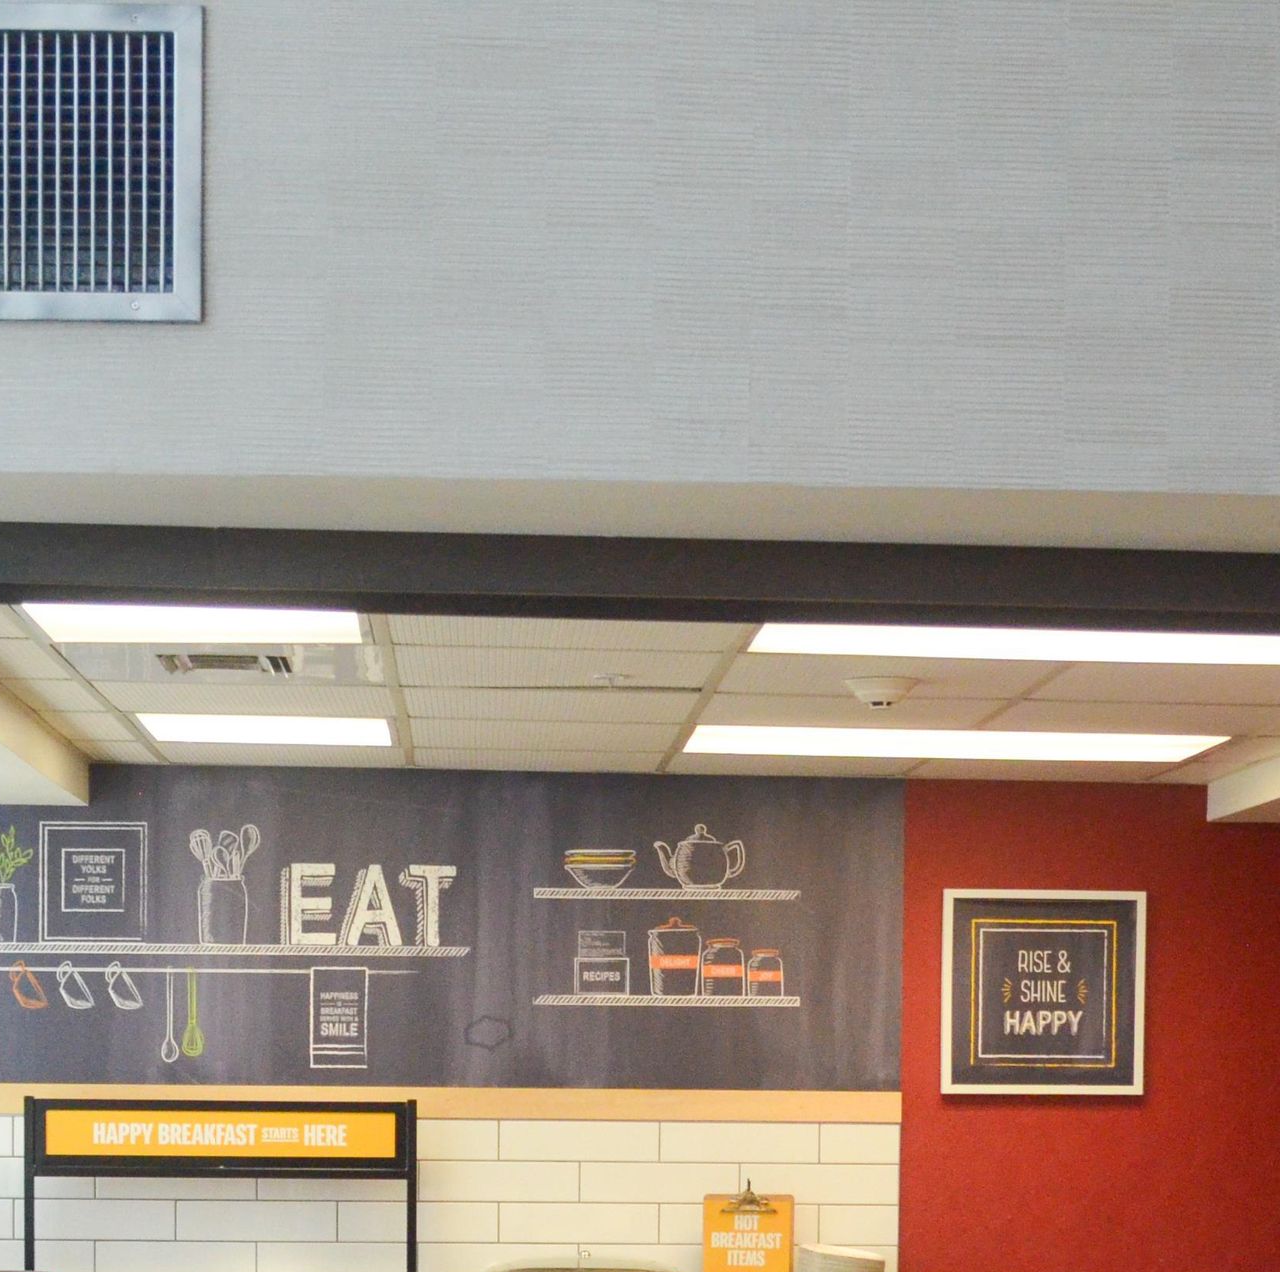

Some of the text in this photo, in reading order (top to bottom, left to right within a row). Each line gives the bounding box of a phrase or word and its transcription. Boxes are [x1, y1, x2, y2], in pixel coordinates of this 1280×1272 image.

[72, 855, 115, 864] DIFFERENT
[81, 865, 107, 874] YOLKS
[72, 885, 115, 894] DIFFERENT
[81, 895, 107, 904] FOLKS
[280, 863, 457, 947] EAT
[1017, 950, 1071, 973] RISE &
[582, 971, 621, 982] RECIPES
[1020, 980, 1067, 1003] SHINE
[320, 1007, 358, 1015] BREAKFAST
[320, 1023, 359, 1036] SMILE
[1004, 1010, 1083, 1036] HAPPY
[93, 1122, 348, 1147] HAPPY BREAKFAST STARTS HERE
[734, 1214, 759, 1231] HOT
[711, 1231, 783, 1249] BREAKFAST
[727, 1249, 766, 1267] ITEMS
